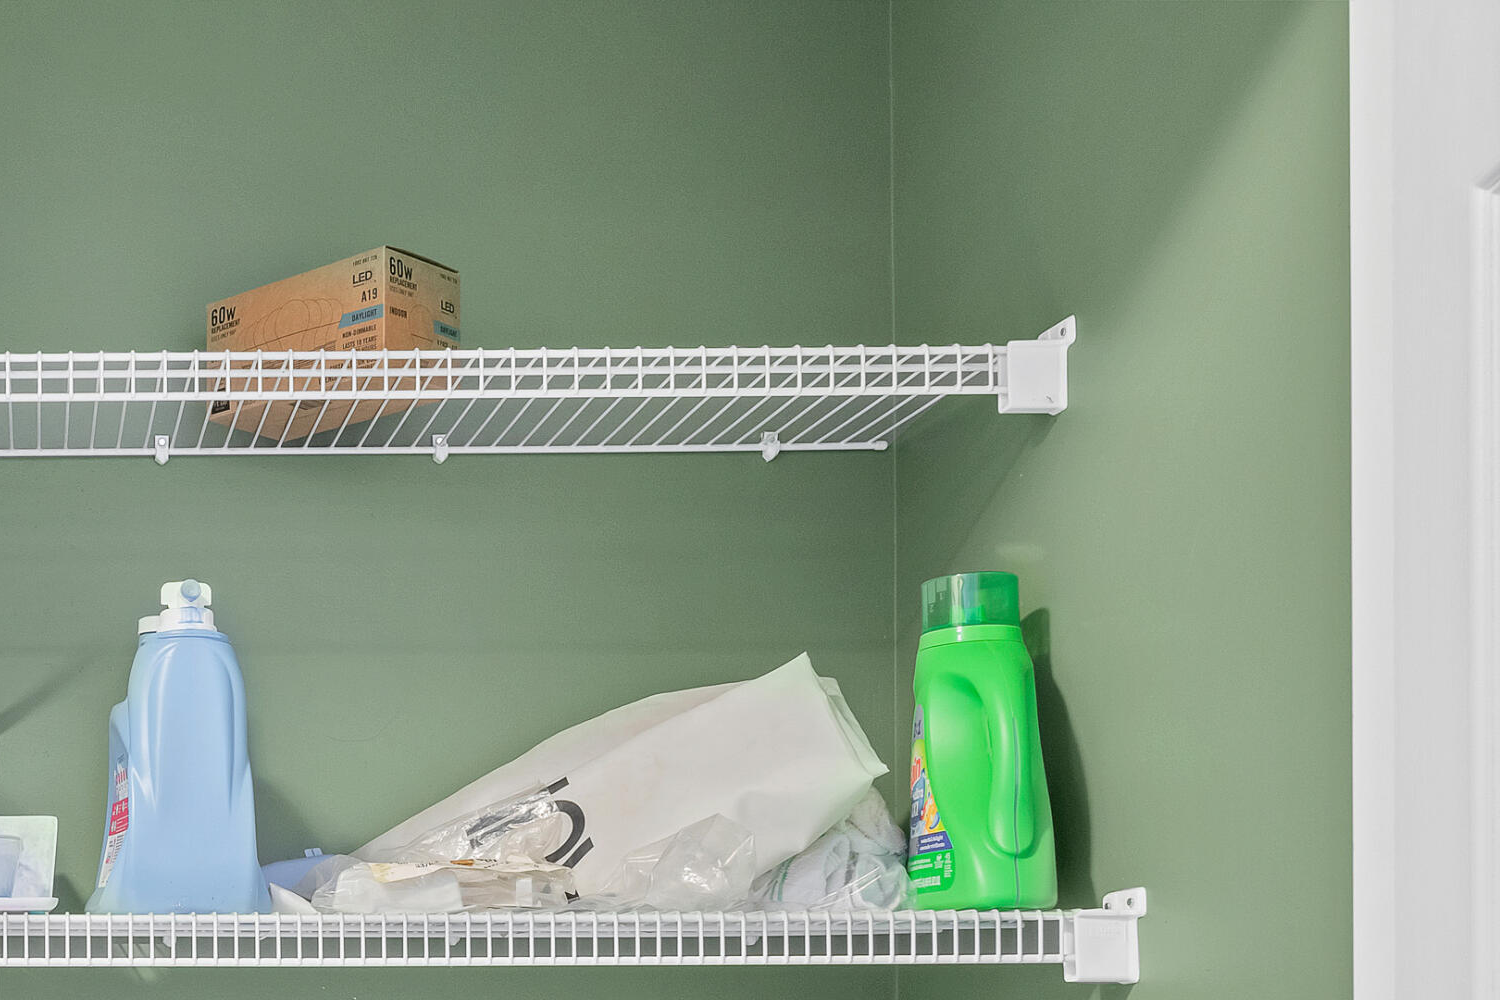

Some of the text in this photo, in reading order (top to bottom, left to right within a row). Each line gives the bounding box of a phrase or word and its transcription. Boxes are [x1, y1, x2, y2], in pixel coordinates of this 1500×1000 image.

[352, 270, 373, 285] LED
[361, 287, 378, 303] A19
[389, 306, 408, 319] INDOOR
[440, 299, 455, 314] LED
[351, 308, 377, 322] DAYLIGHT
